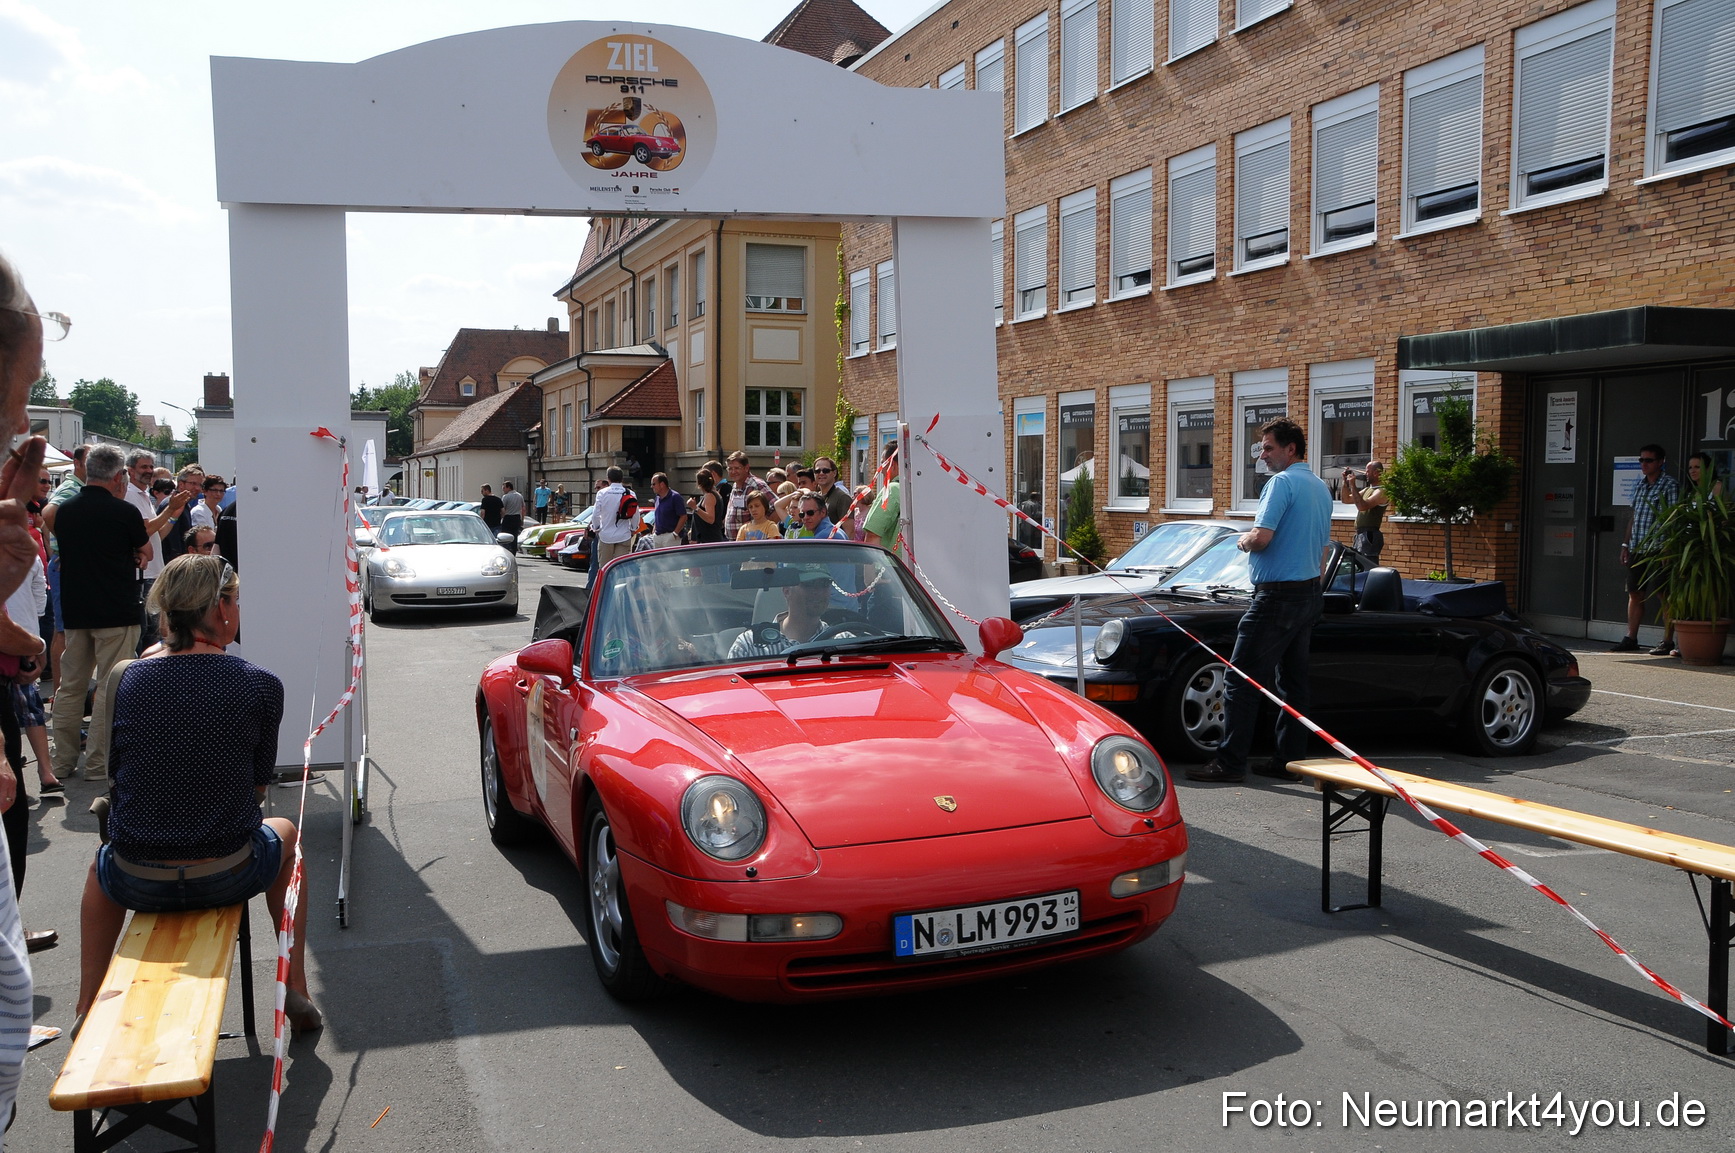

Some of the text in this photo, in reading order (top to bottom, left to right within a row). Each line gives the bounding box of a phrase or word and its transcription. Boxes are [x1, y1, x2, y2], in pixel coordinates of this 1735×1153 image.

[606, 42, 659, 73] ZIEL
[585, 75, 678, 88] PORSCHE
[620, 84, 645, 94] 911
[1064, 896, 1075, 906] 04
[914, 898, 1058, 950] N LM 993
[1065, 917, 1076, 927] 10
[901, 939, 908, 949] D
[960, 944, 1010, 956] Sportwagen-Service
